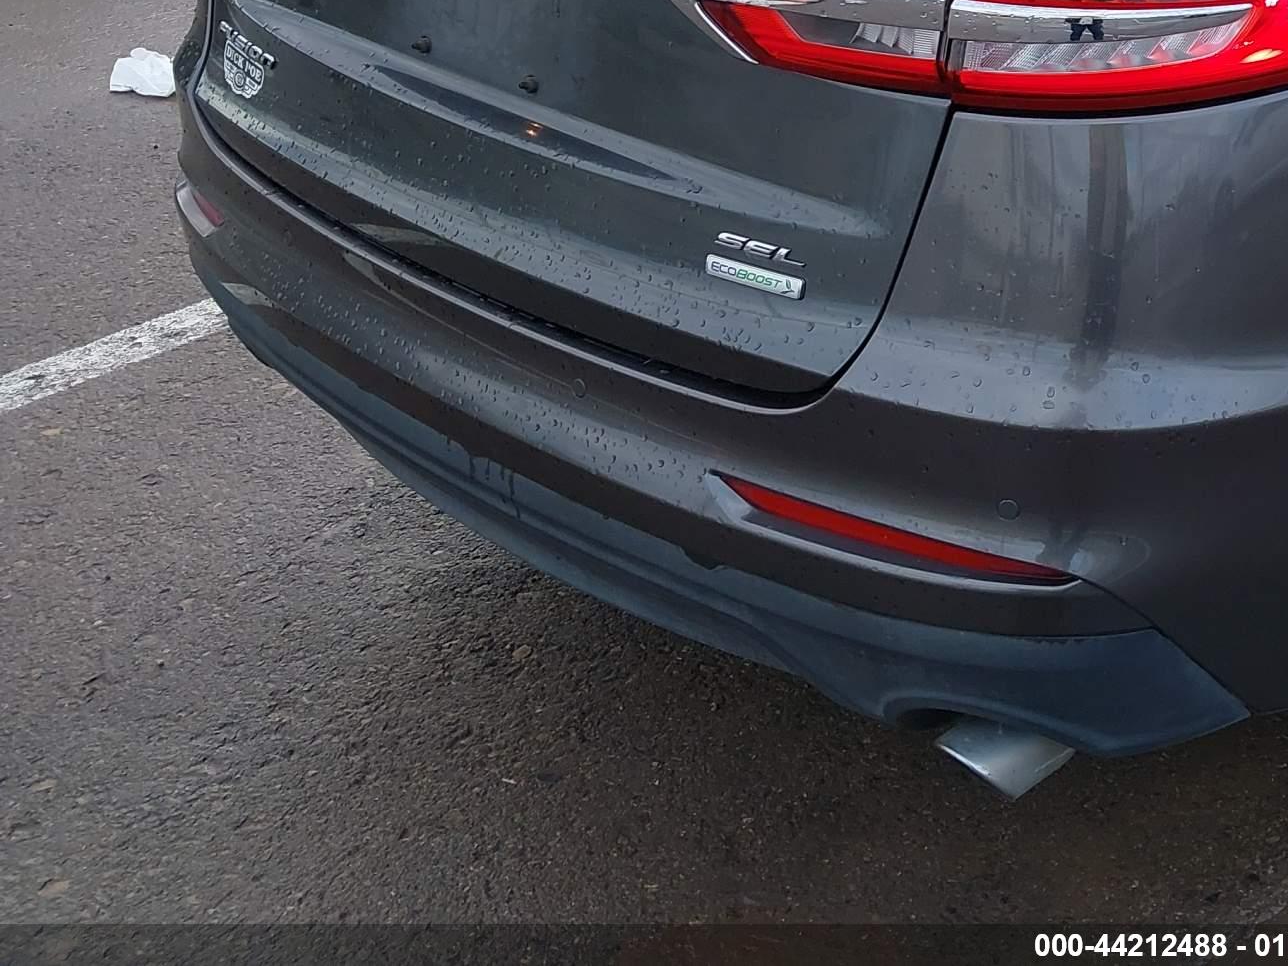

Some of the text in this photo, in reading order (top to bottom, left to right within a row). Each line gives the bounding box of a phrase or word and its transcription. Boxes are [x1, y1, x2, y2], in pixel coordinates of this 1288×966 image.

[226, 45, 263, 84] DICK POE
[714, 232, 806, 266] SEL
